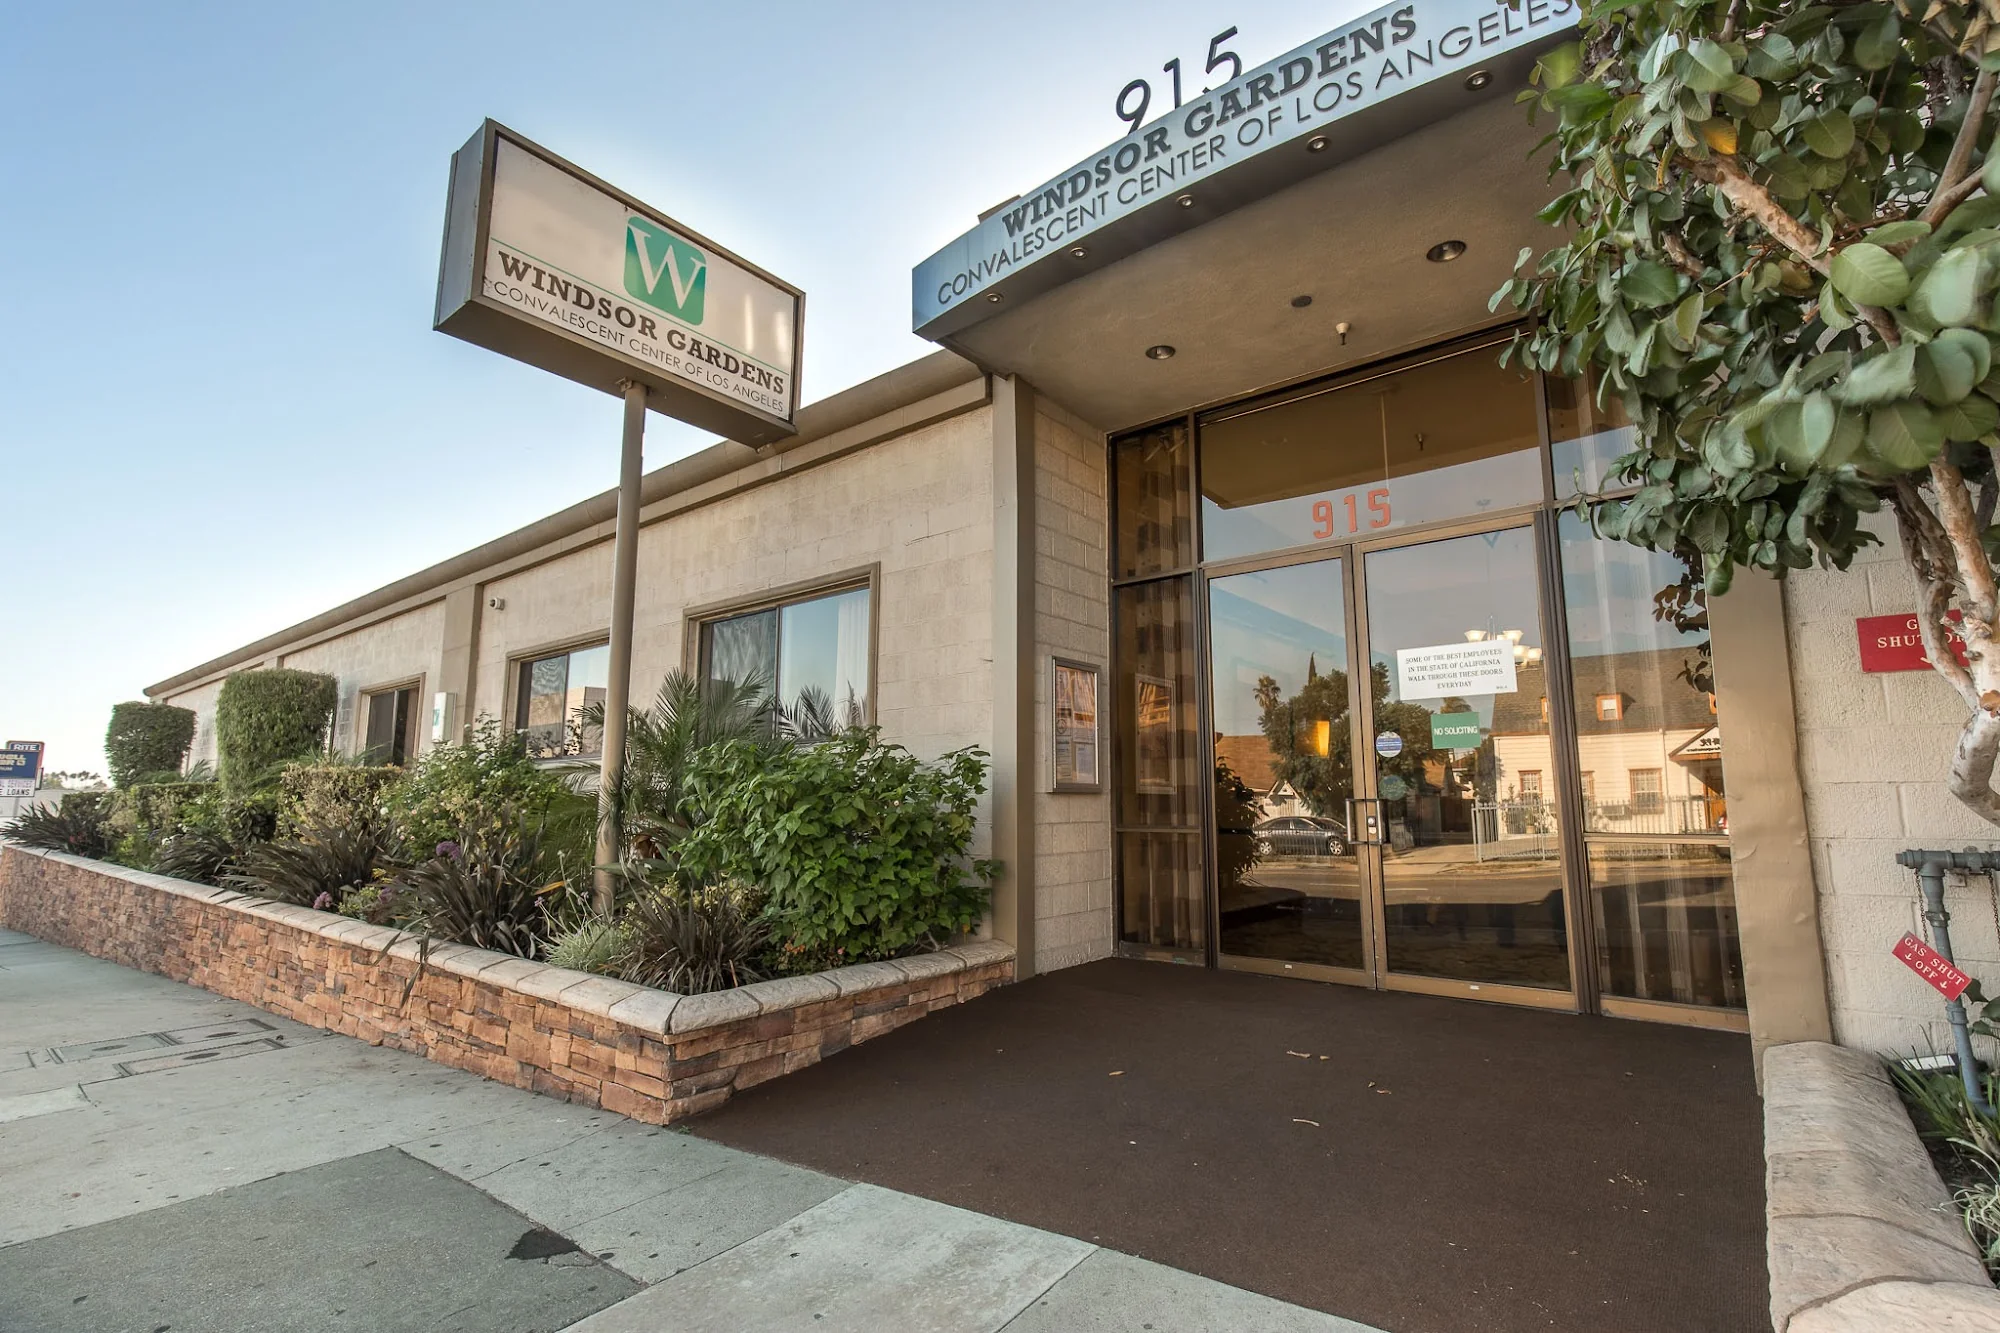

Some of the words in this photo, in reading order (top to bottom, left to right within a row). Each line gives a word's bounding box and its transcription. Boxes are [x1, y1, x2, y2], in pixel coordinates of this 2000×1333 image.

[1116, 25, 1243, 136] 915
[1002, 126, 1172, 238] WINDSOR
[1184, 4, 1417, 139] GARDENS
[938, 190, 1109, 305] CONVALESCENT
[1117, 134, 1226, 205] CENTER
[1237, 106, 1283, 147] OF
[1296, 71, 1363, 123] LOS
[628, 223, 707, 310] W
[494, 281, 625, 345] CONVALESCENT
[629, 338, 681, 369] CENTER
[685, 362, 703, 377] OF
[706, 370, 729, 389] LOS
[732, 383, 784, 413] ANGELES
[498, 250, 658, 341] WINDSOR
[666, 329, 784, 396] GARDENS
[1312, 487, 1392, 539] 915
[1405, 656, 1423, 664] SOME
[1446, 652, 1462, 660] BEST
[1463, 648, 1502, 659] EMPLOYEES
[1427, 672, 1458, 680] THROUGH
[1458, 670, 1479, 678] THESE
[1480, 668, 1503, 676] DOORS
[1429, 663, 1448, 671] STATE
[1459, 658, 1501, 668] CALIFORNIA
[1437, 680, 1473, 689] EVERYDAY
[1433, 727, 1444, 736] NO
[1444, 725, 1478, 735] SOLICITING
[7, 788, 30, 796] LOANS
[1904, 937, 1927, 957] GAS
[1930, 958, 1965, 985] SHUT
[1915, 960, 1938, 979] OFF
